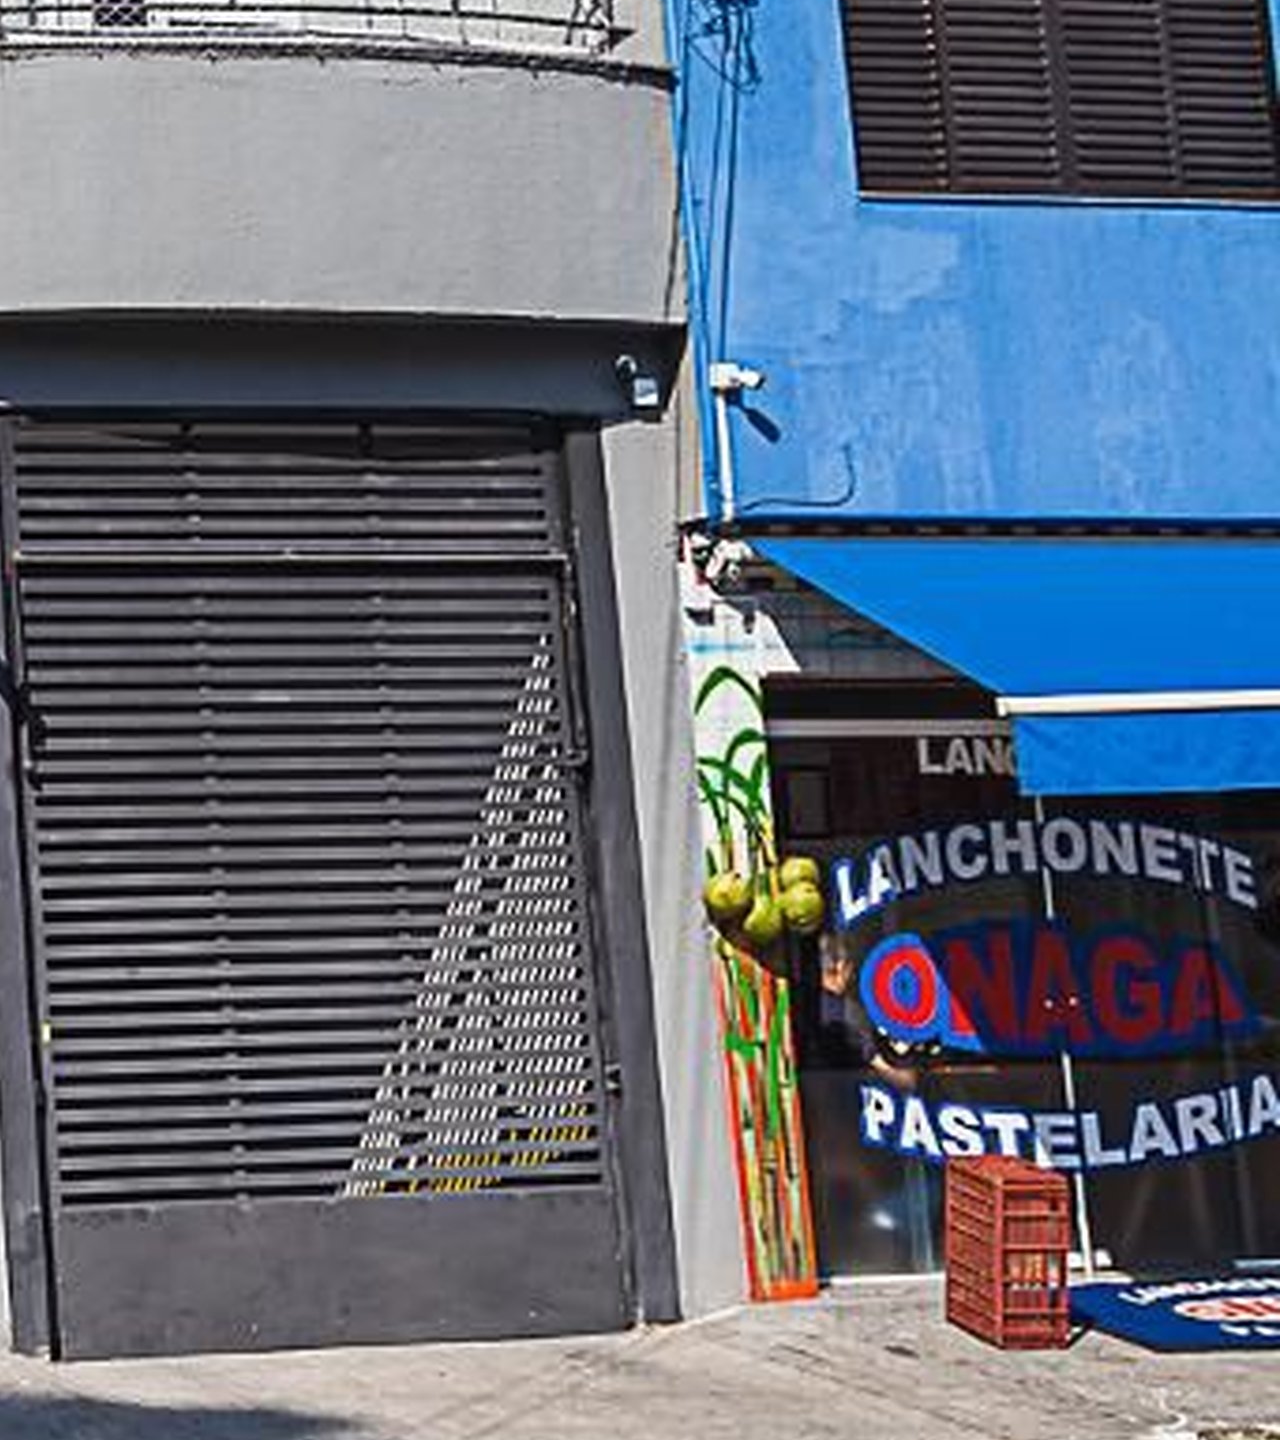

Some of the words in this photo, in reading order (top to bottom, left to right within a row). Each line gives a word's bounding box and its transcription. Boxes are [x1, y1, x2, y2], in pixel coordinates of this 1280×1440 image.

[834, 817, 1260, 923] LANCHONETE
[871, 930, 1246, 1046] ONAGA
[862, 1074, 1280, 1170] PASTELARIA
